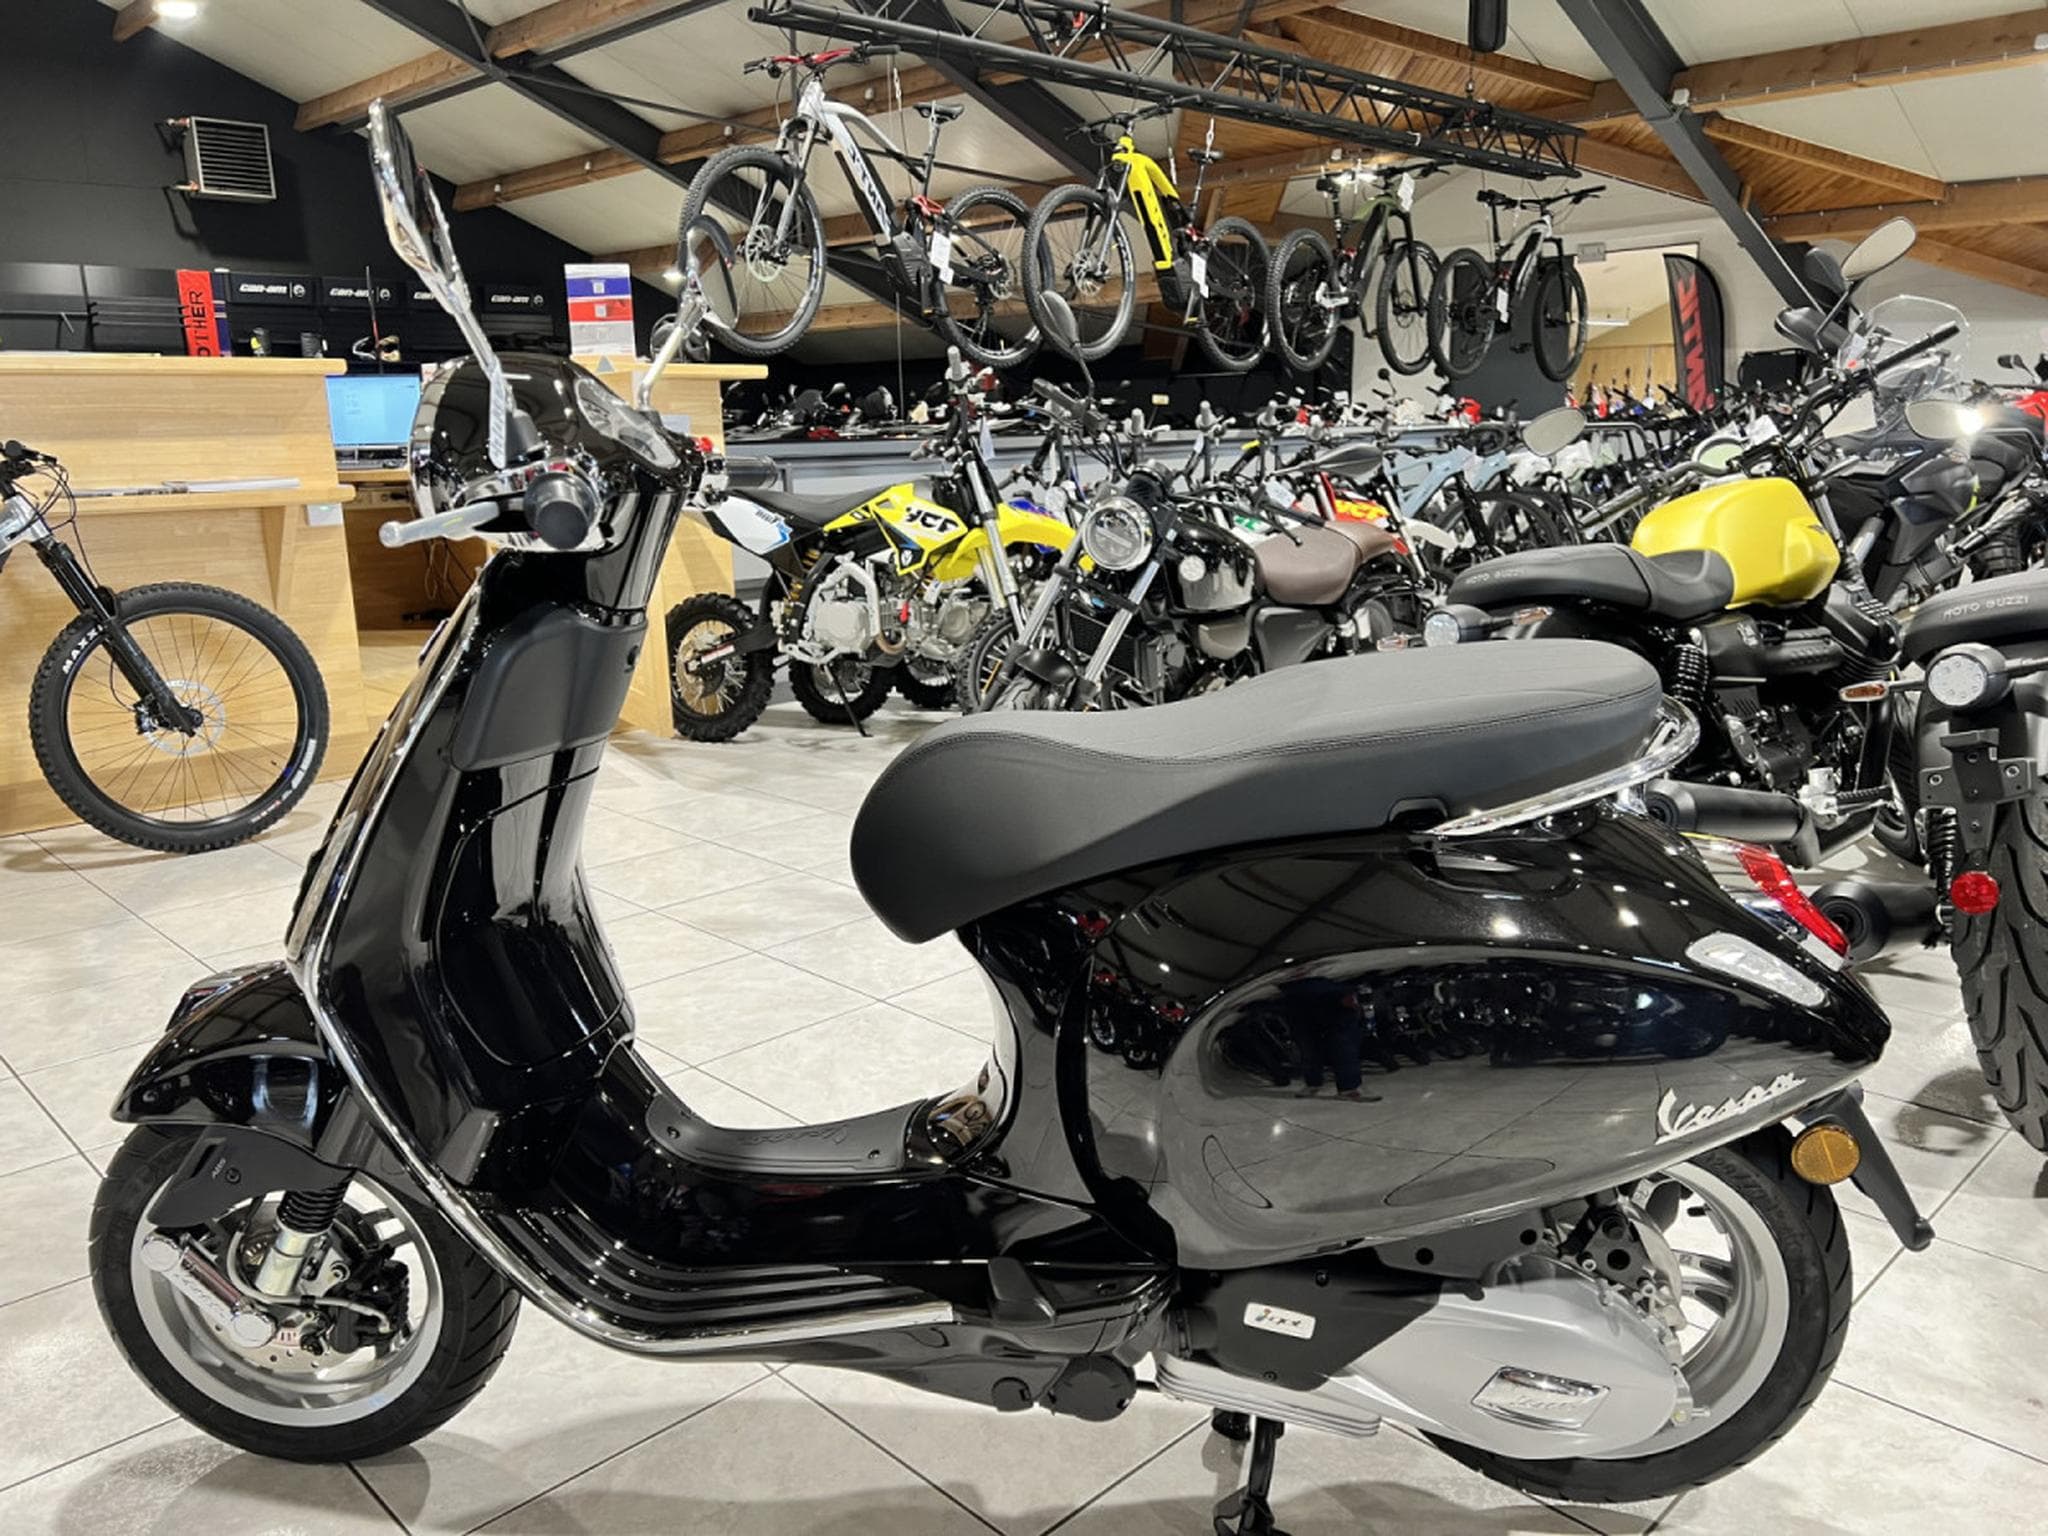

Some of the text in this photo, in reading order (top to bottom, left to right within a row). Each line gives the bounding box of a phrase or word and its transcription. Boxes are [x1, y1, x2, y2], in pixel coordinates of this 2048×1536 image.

[1943, 595, 2028, 620] MOTO GUZZI
[1654, 1071, 1807, 1146] Vespa
